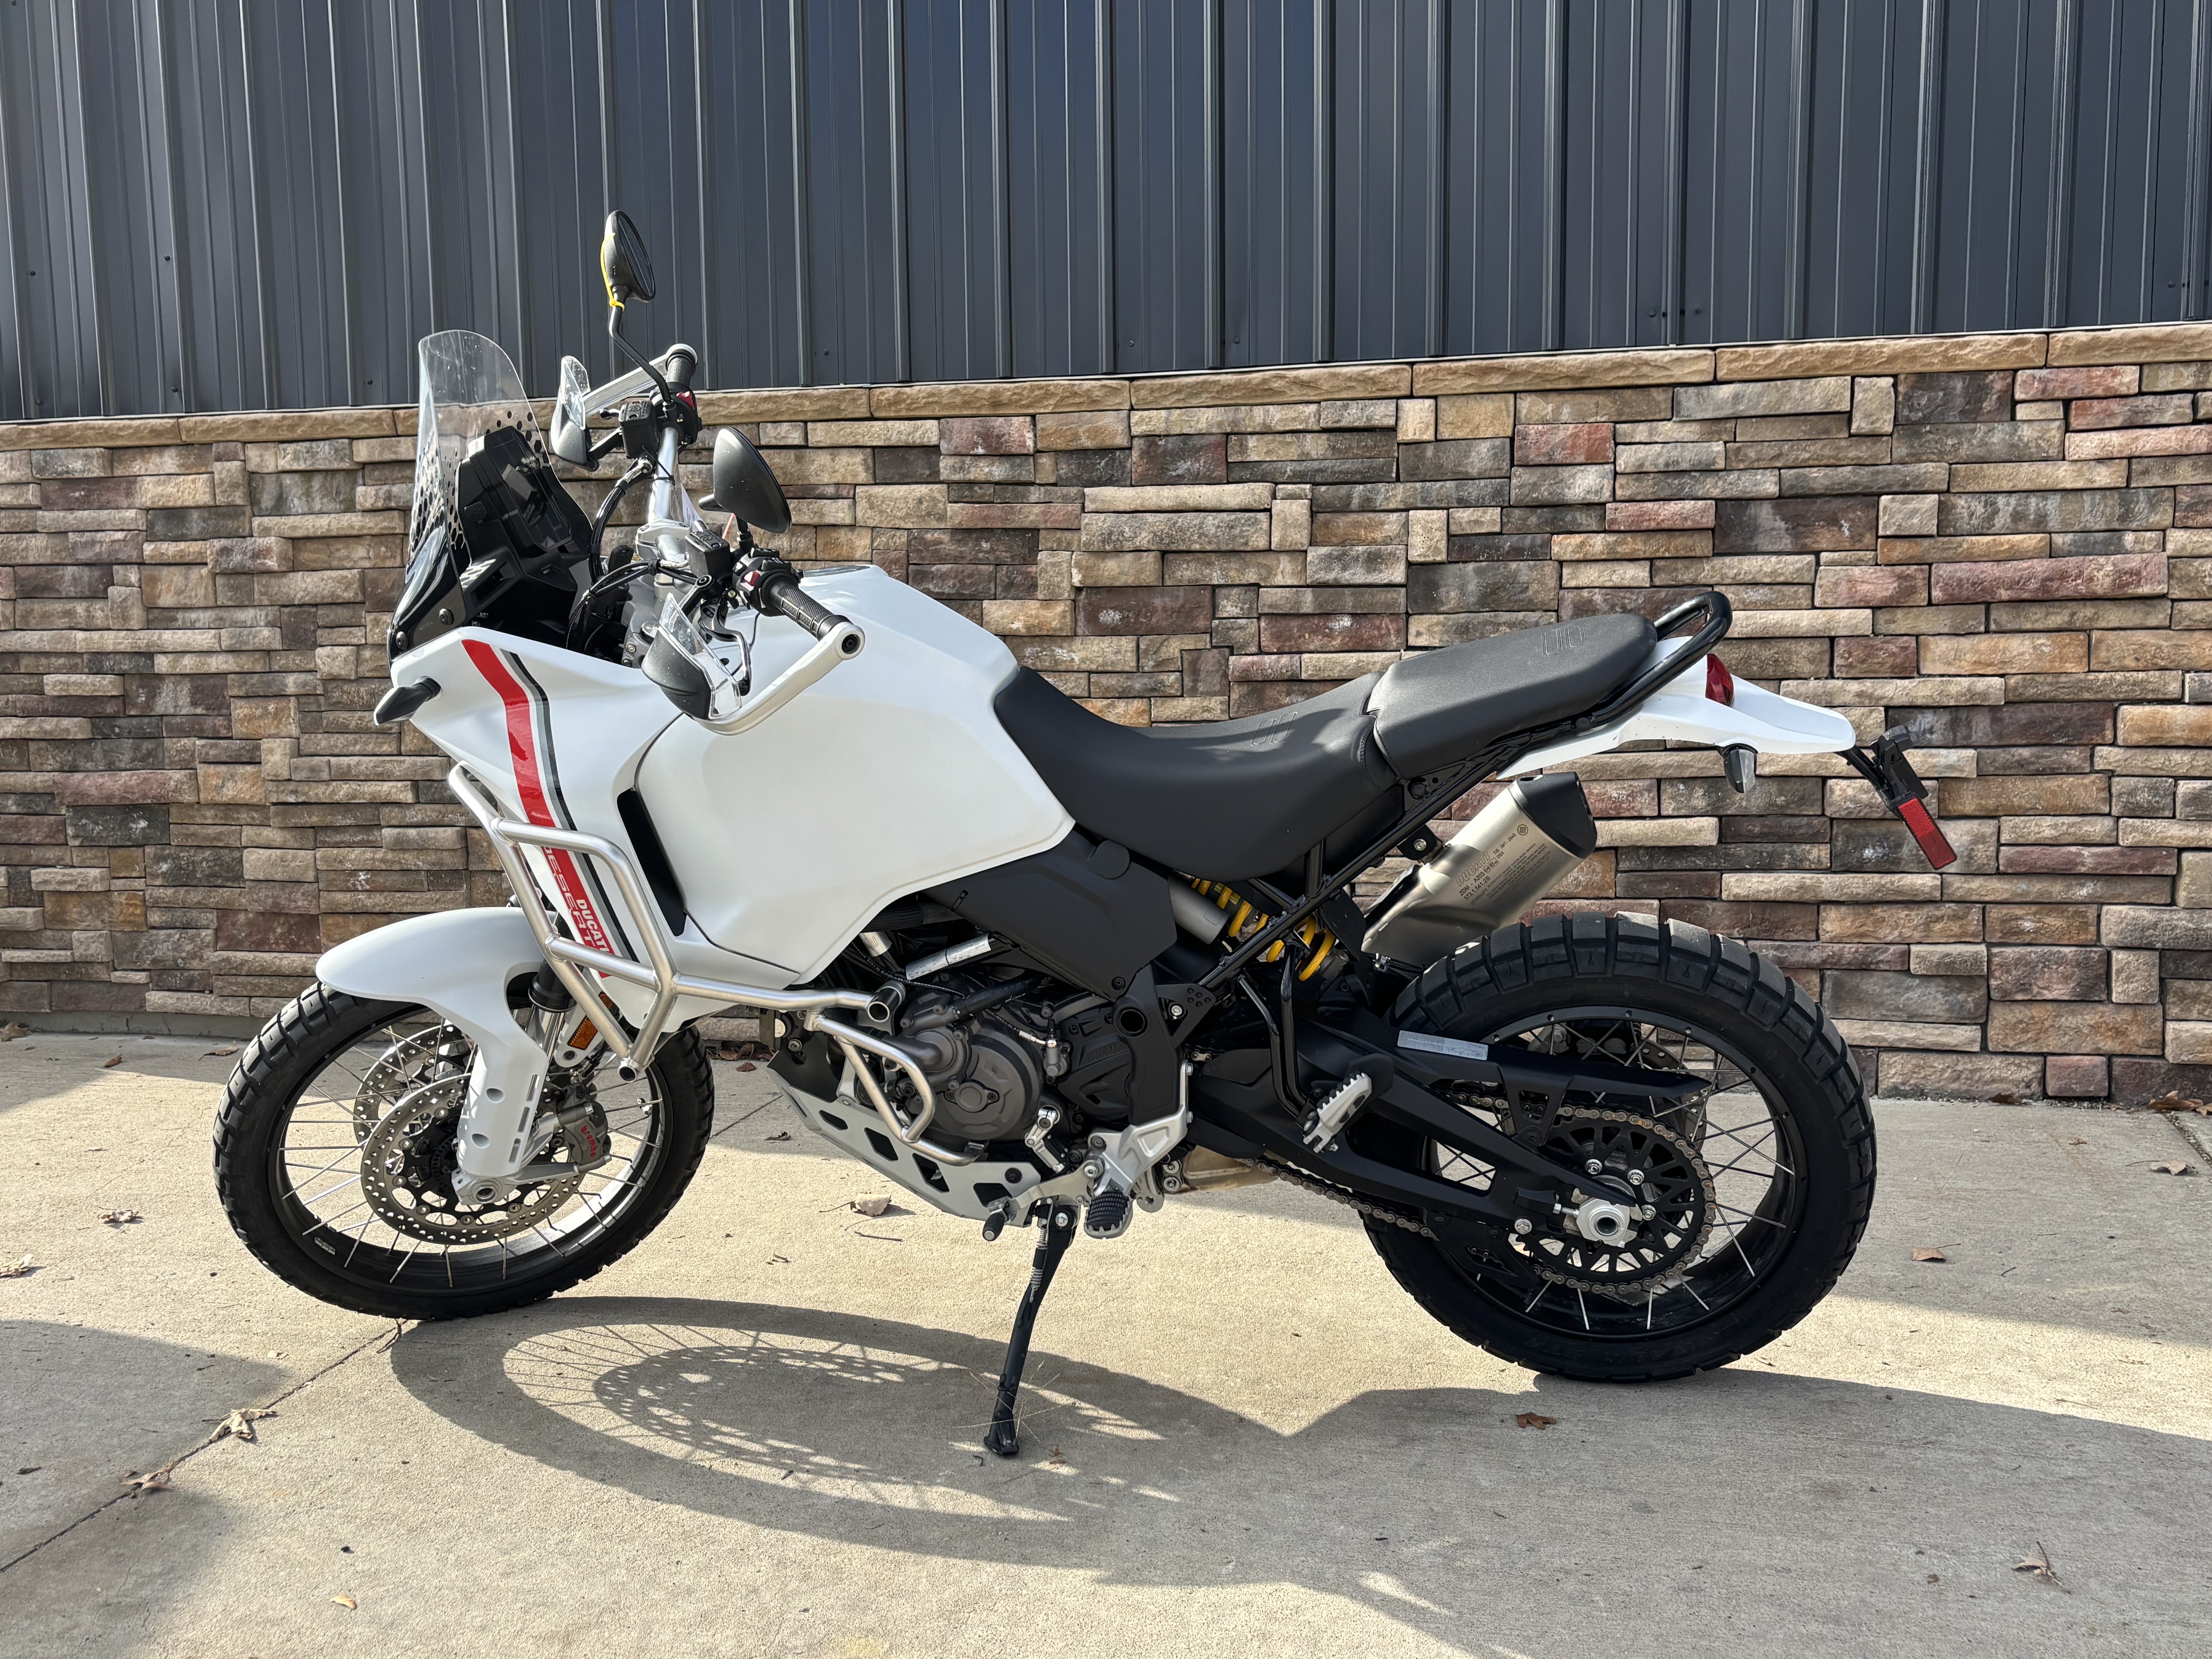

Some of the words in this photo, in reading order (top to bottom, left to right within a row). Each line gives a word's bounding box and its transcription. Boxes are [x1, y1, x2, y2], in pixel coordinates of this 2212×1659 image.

[1456, 852, 1490, 887] DUCATI
[1459, 885, 1471, 896] ZDM
[1474, 872, 1486, 883] A203
[575, 899, 610, 951] DUCATI
[581, 1125, 598, 1157] brembo
